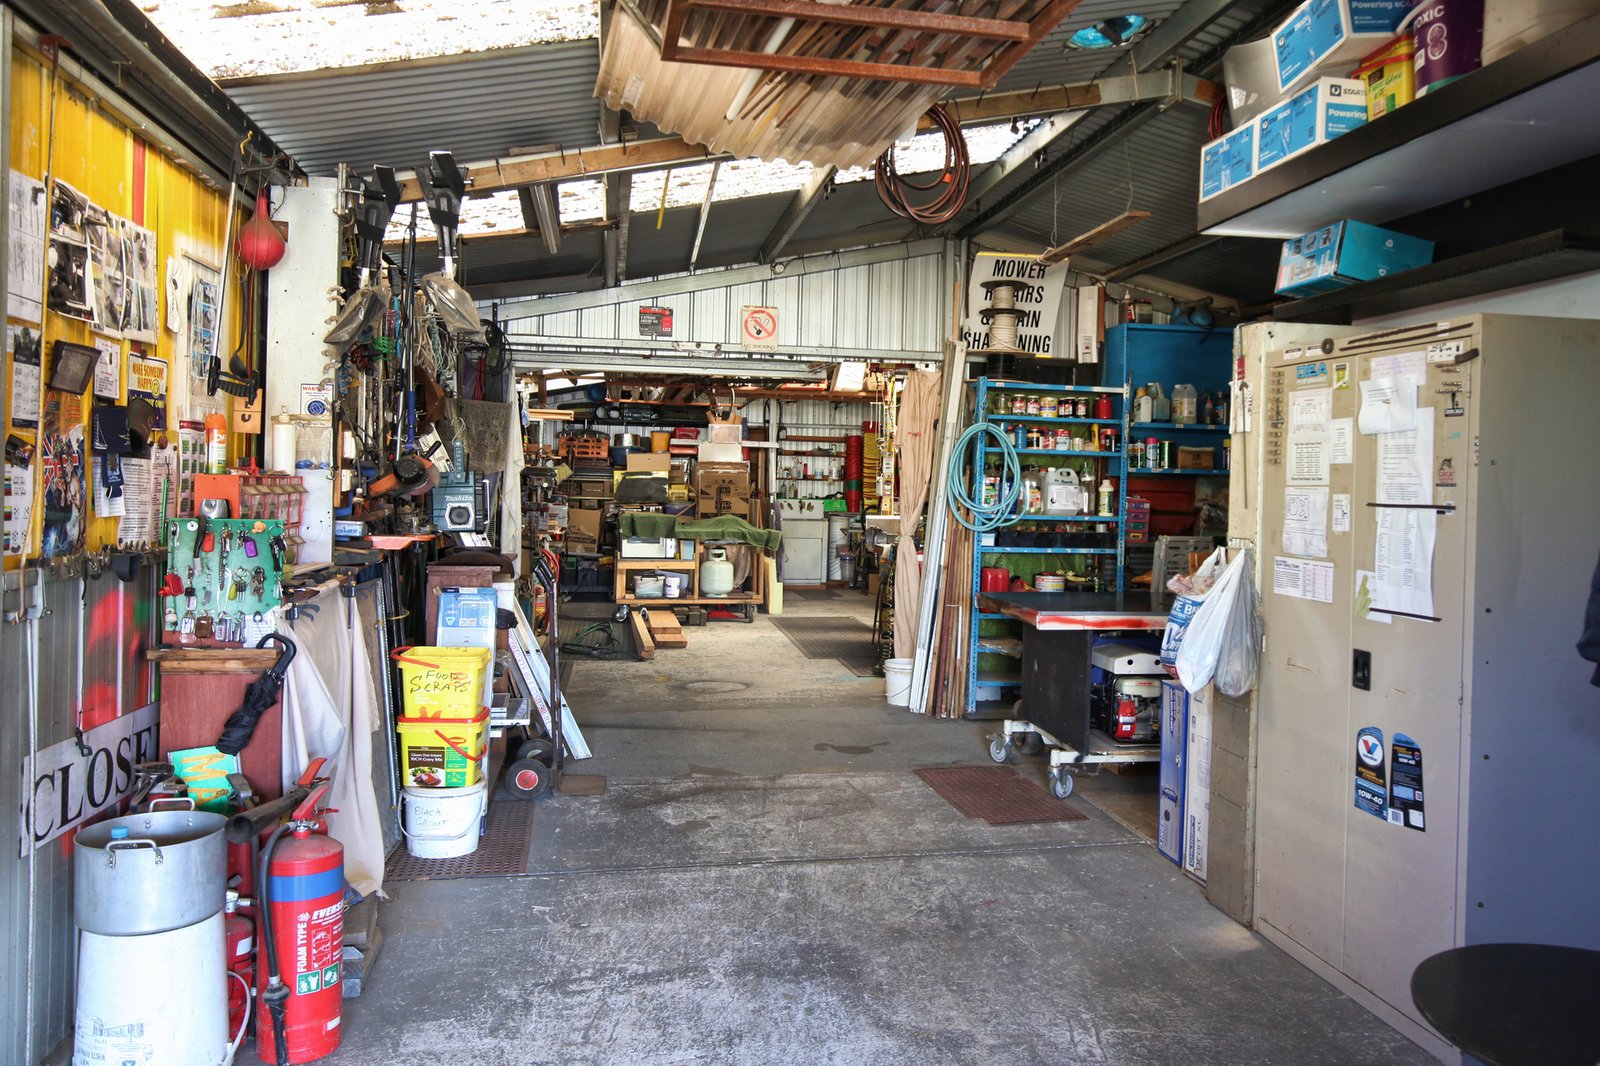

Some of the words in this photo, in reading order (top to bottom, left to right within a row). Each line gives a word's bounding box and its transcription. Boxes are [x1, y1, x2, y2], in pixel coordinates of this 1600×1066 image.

[1352, 1, 1392, 10] Powering
[1328, 108, 1367, 120] Powering
[992, 260, 1048, 279] MOWER
[964, 332, 1051, 353] SHANING
[144, 364, 164, 380] SOMEONE
[138, 376, 152, 390] HAPPY
[426, 670, 458, 681] FOOD
[410, 675, 472, 694] SCRAPS
[1358, 789, 1383, 804] 10W-40
[297, 922, 308, 946] TYPE
[297, 946, 308, 972] FOAM
